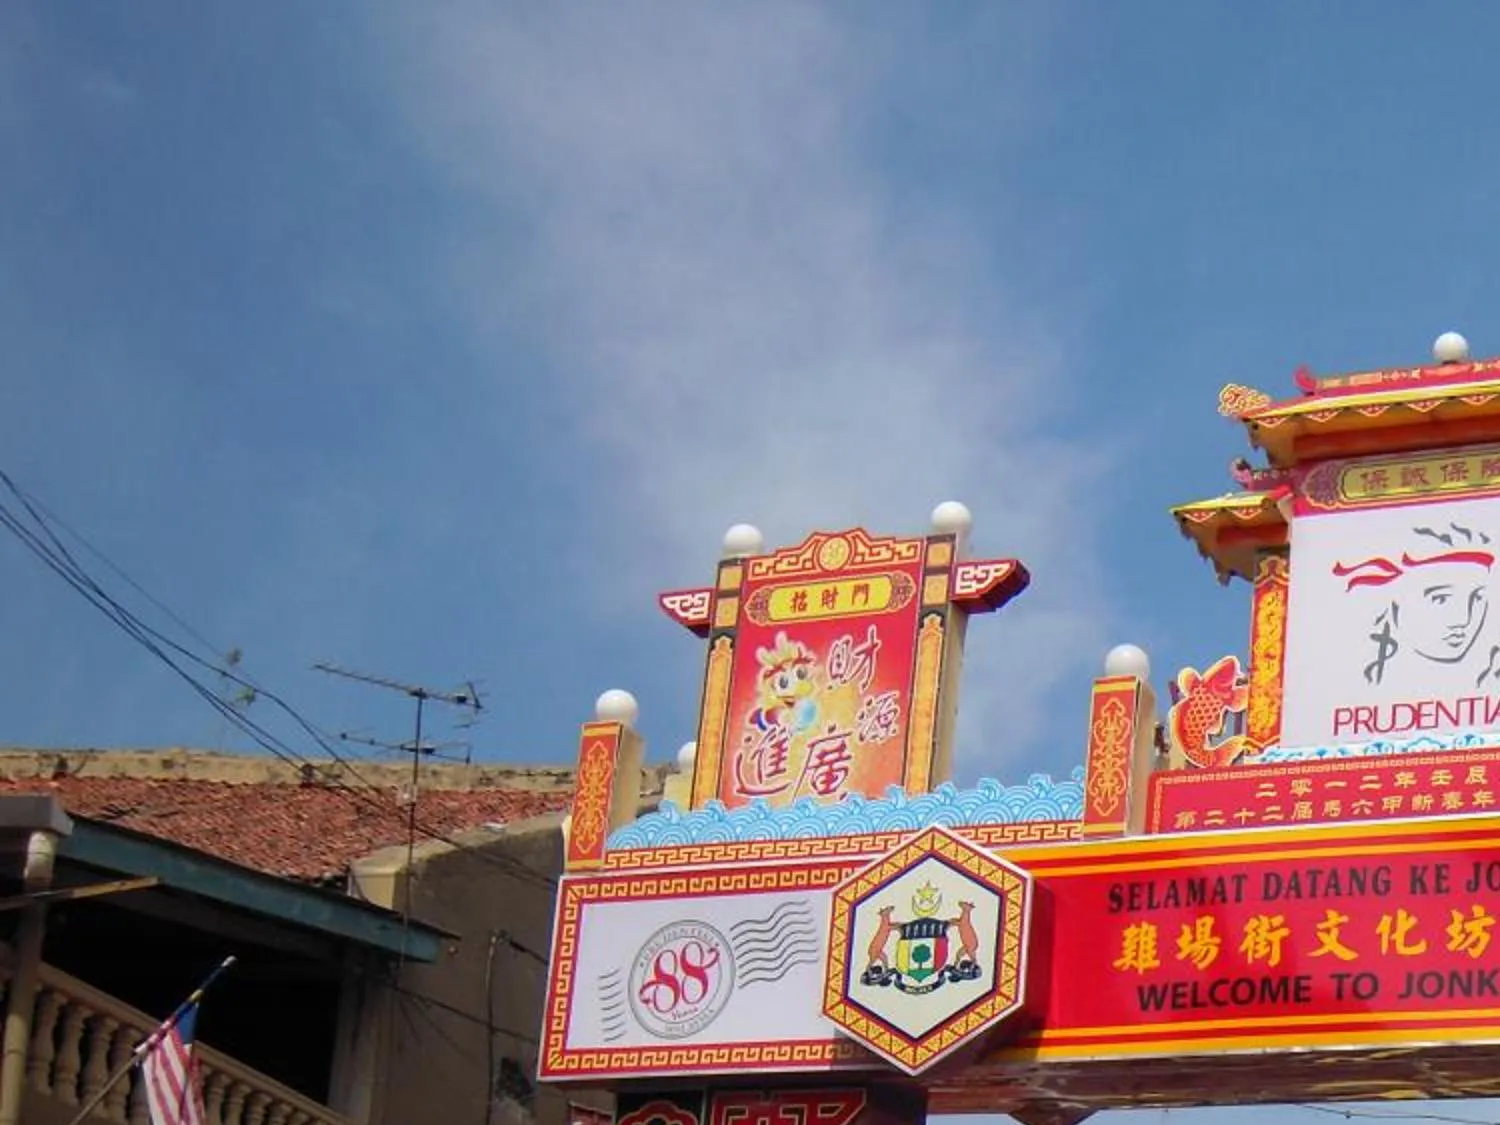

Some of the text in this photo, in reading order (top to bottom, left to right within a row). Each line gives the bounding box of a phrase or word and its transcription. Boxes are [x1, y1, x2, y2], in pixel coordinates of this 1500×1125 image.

[1107, 873, 1249, 914] SELAMAT
[1262, 865, 1392, 901] DATANG
[1409, 863, 1450, 896] KE
[639, 940, 720, 1013] 88
[1137, 975, 1312, 1012] WELCOME
[1329, 971, 1380, 1000] TO
